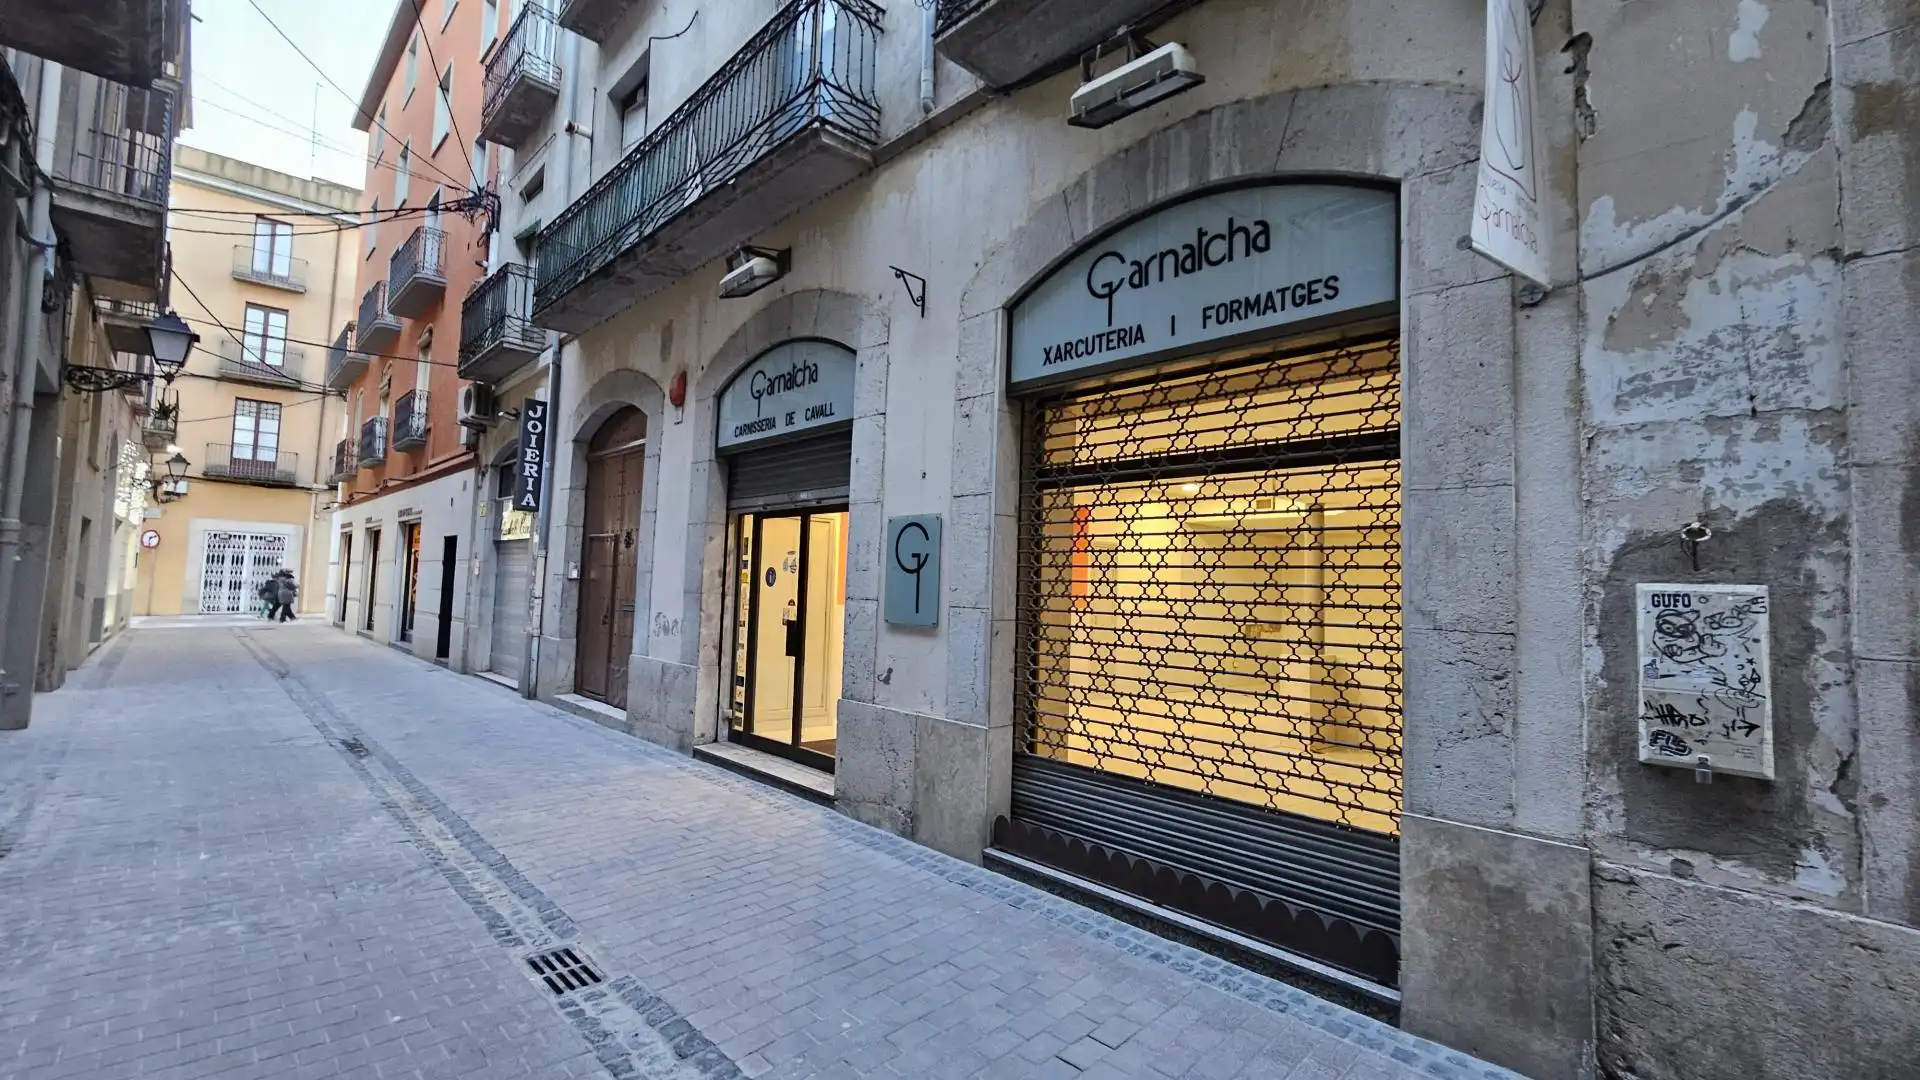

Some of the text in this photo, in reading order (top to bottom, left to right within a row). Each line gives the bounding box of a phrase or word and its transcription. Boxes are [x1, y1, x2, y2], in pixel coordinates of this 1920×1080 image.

[1087, 216, 1271, 327] Garnatcha
[1043, 275, 1340, 366] XARCUTERIA I FORMATGES
[734, 402, 835, 438] CARNISSERIA DE CAVALL
[750, 359, 818, 418] Garnatcha
[520, 405, 544, 507] JOIERIA
[1651, 593, 1692, 608] GUFO
